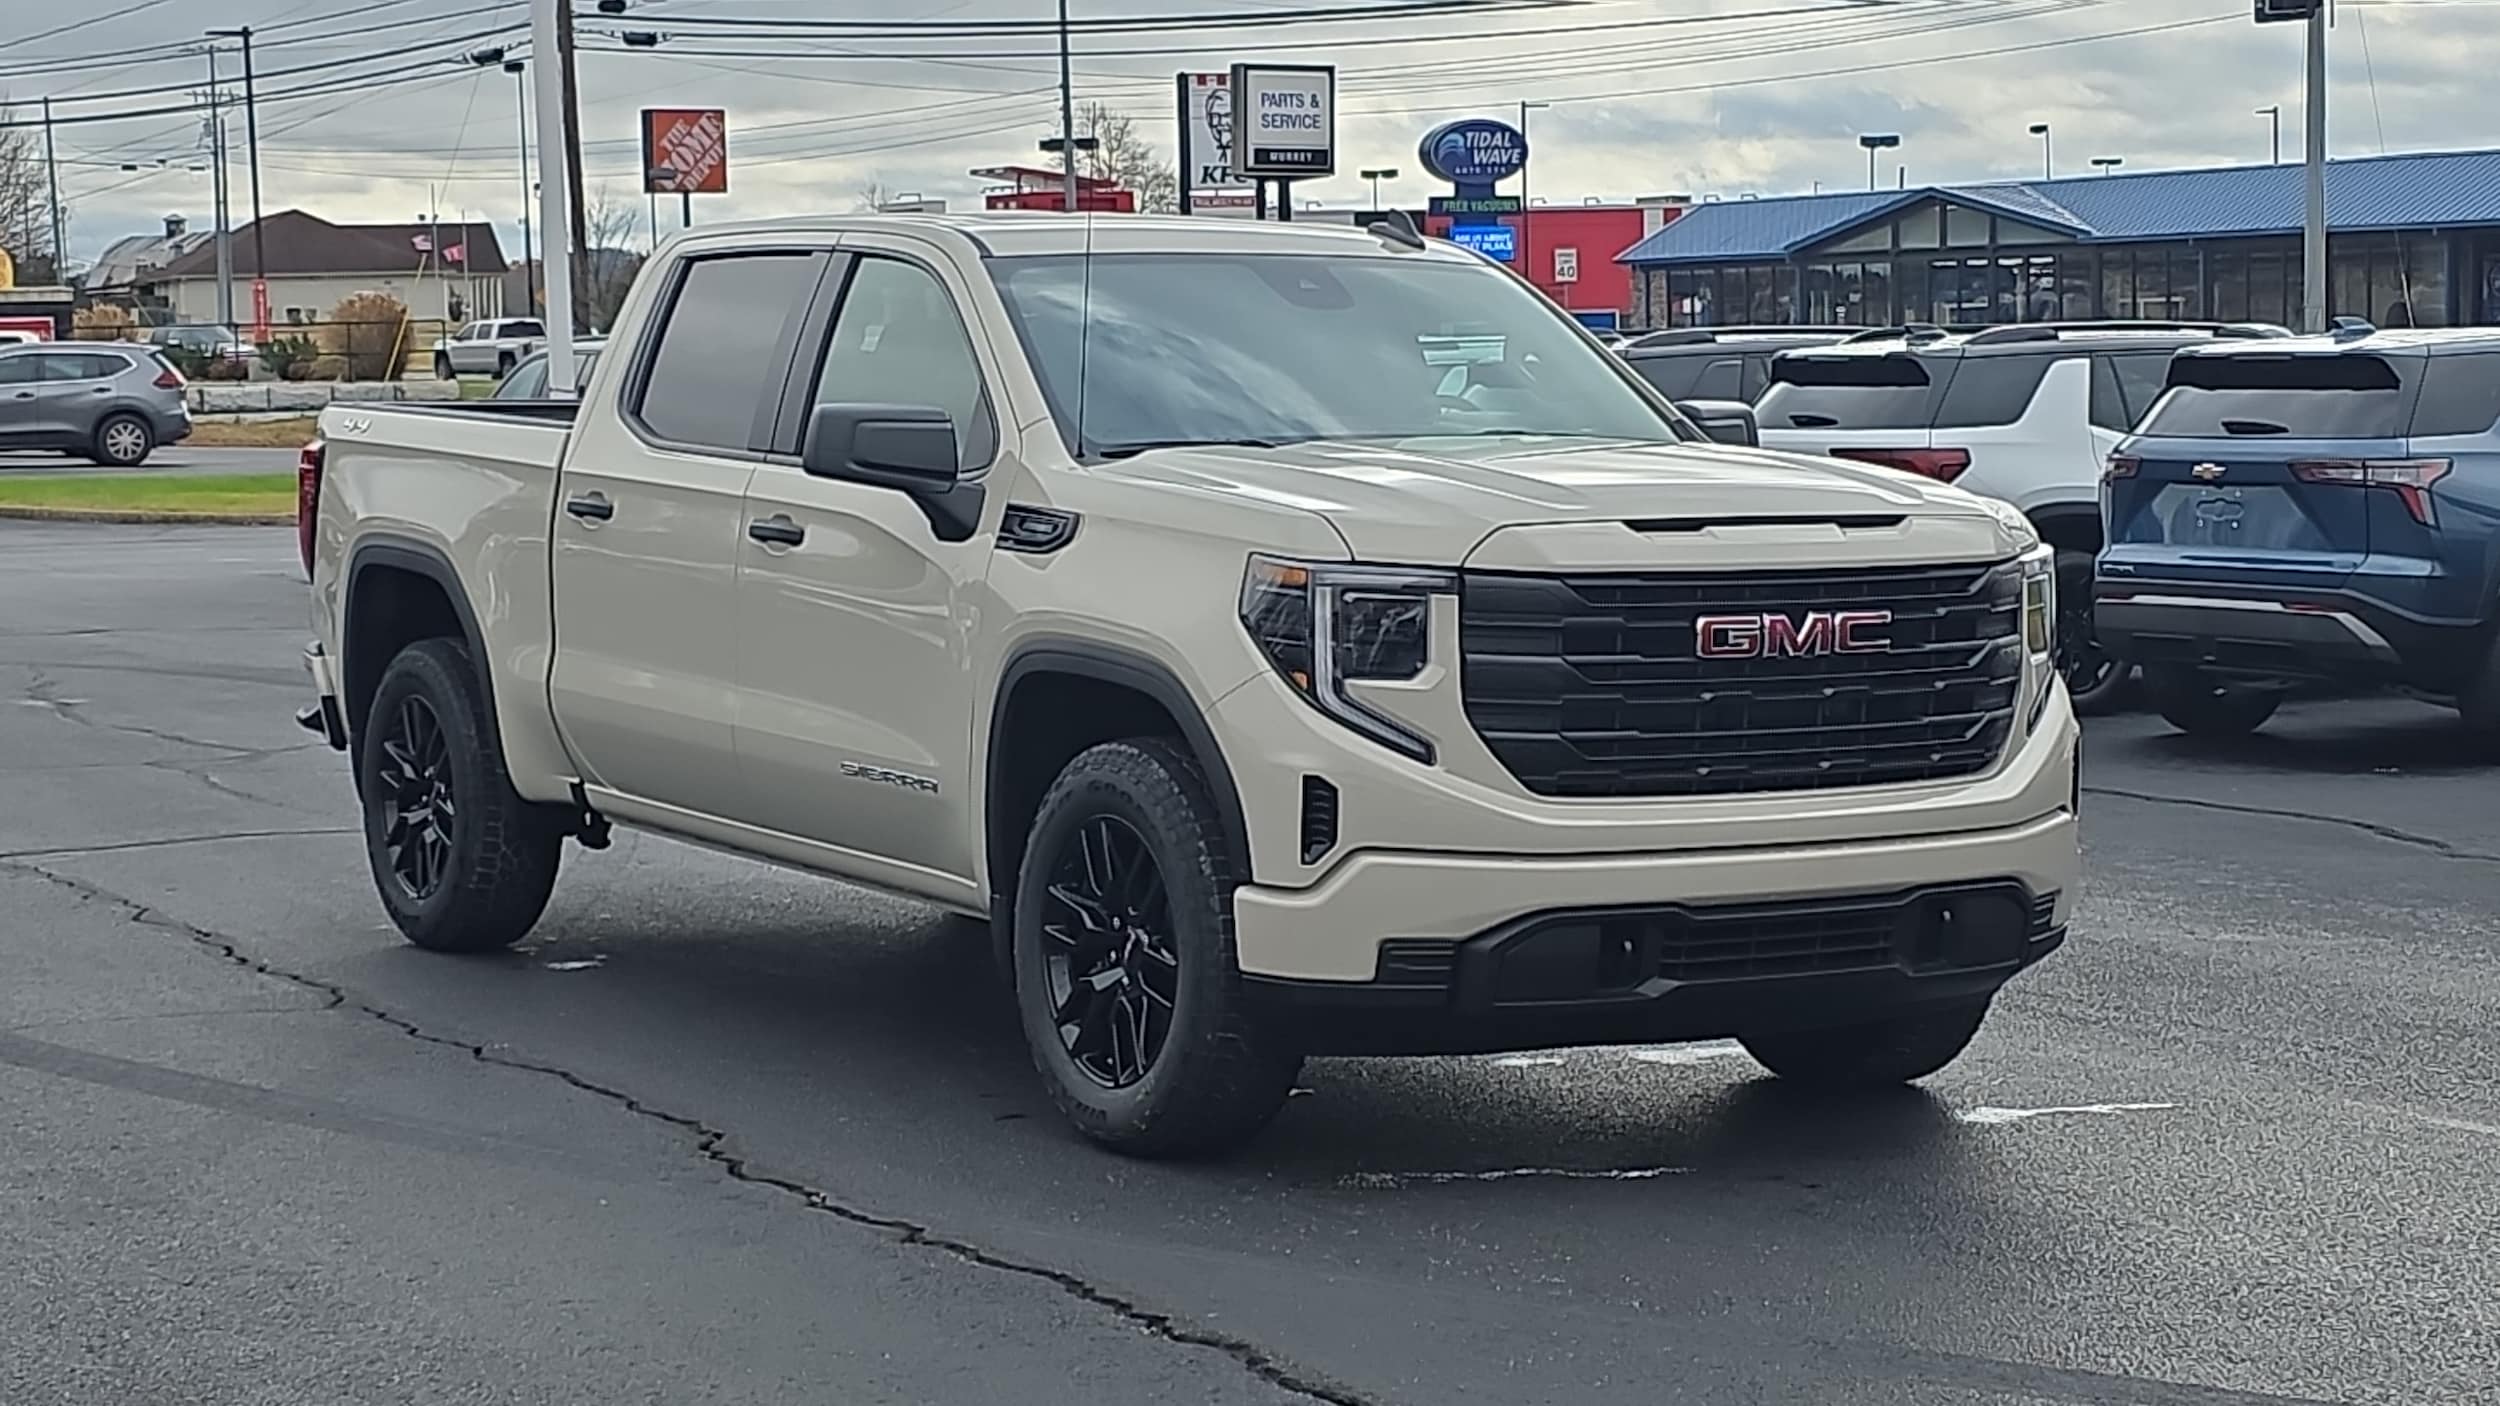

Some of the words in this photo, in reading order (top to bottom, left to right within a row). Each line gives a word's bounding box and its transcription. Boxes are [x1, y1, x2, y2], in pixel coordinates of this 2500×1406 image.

[1261, 92, 1305, 108] PARTS
[1309, 93, 1320, 108] &
[1261, 113, 1321, 129] SERVICE
[659, 118, 690, 152] THE
[1465, 131, 1512, 149] TIDAL
[655, 112, 723, 190] HOME
[1473, 148, 1521, 165] WAVE
[683, 141, 724, 191] DEPOT
[1557, 265, 1576, 278] 40
[1696, 611, 1893, 659] GMC
[840, 760, 939, 795] SIERRA
